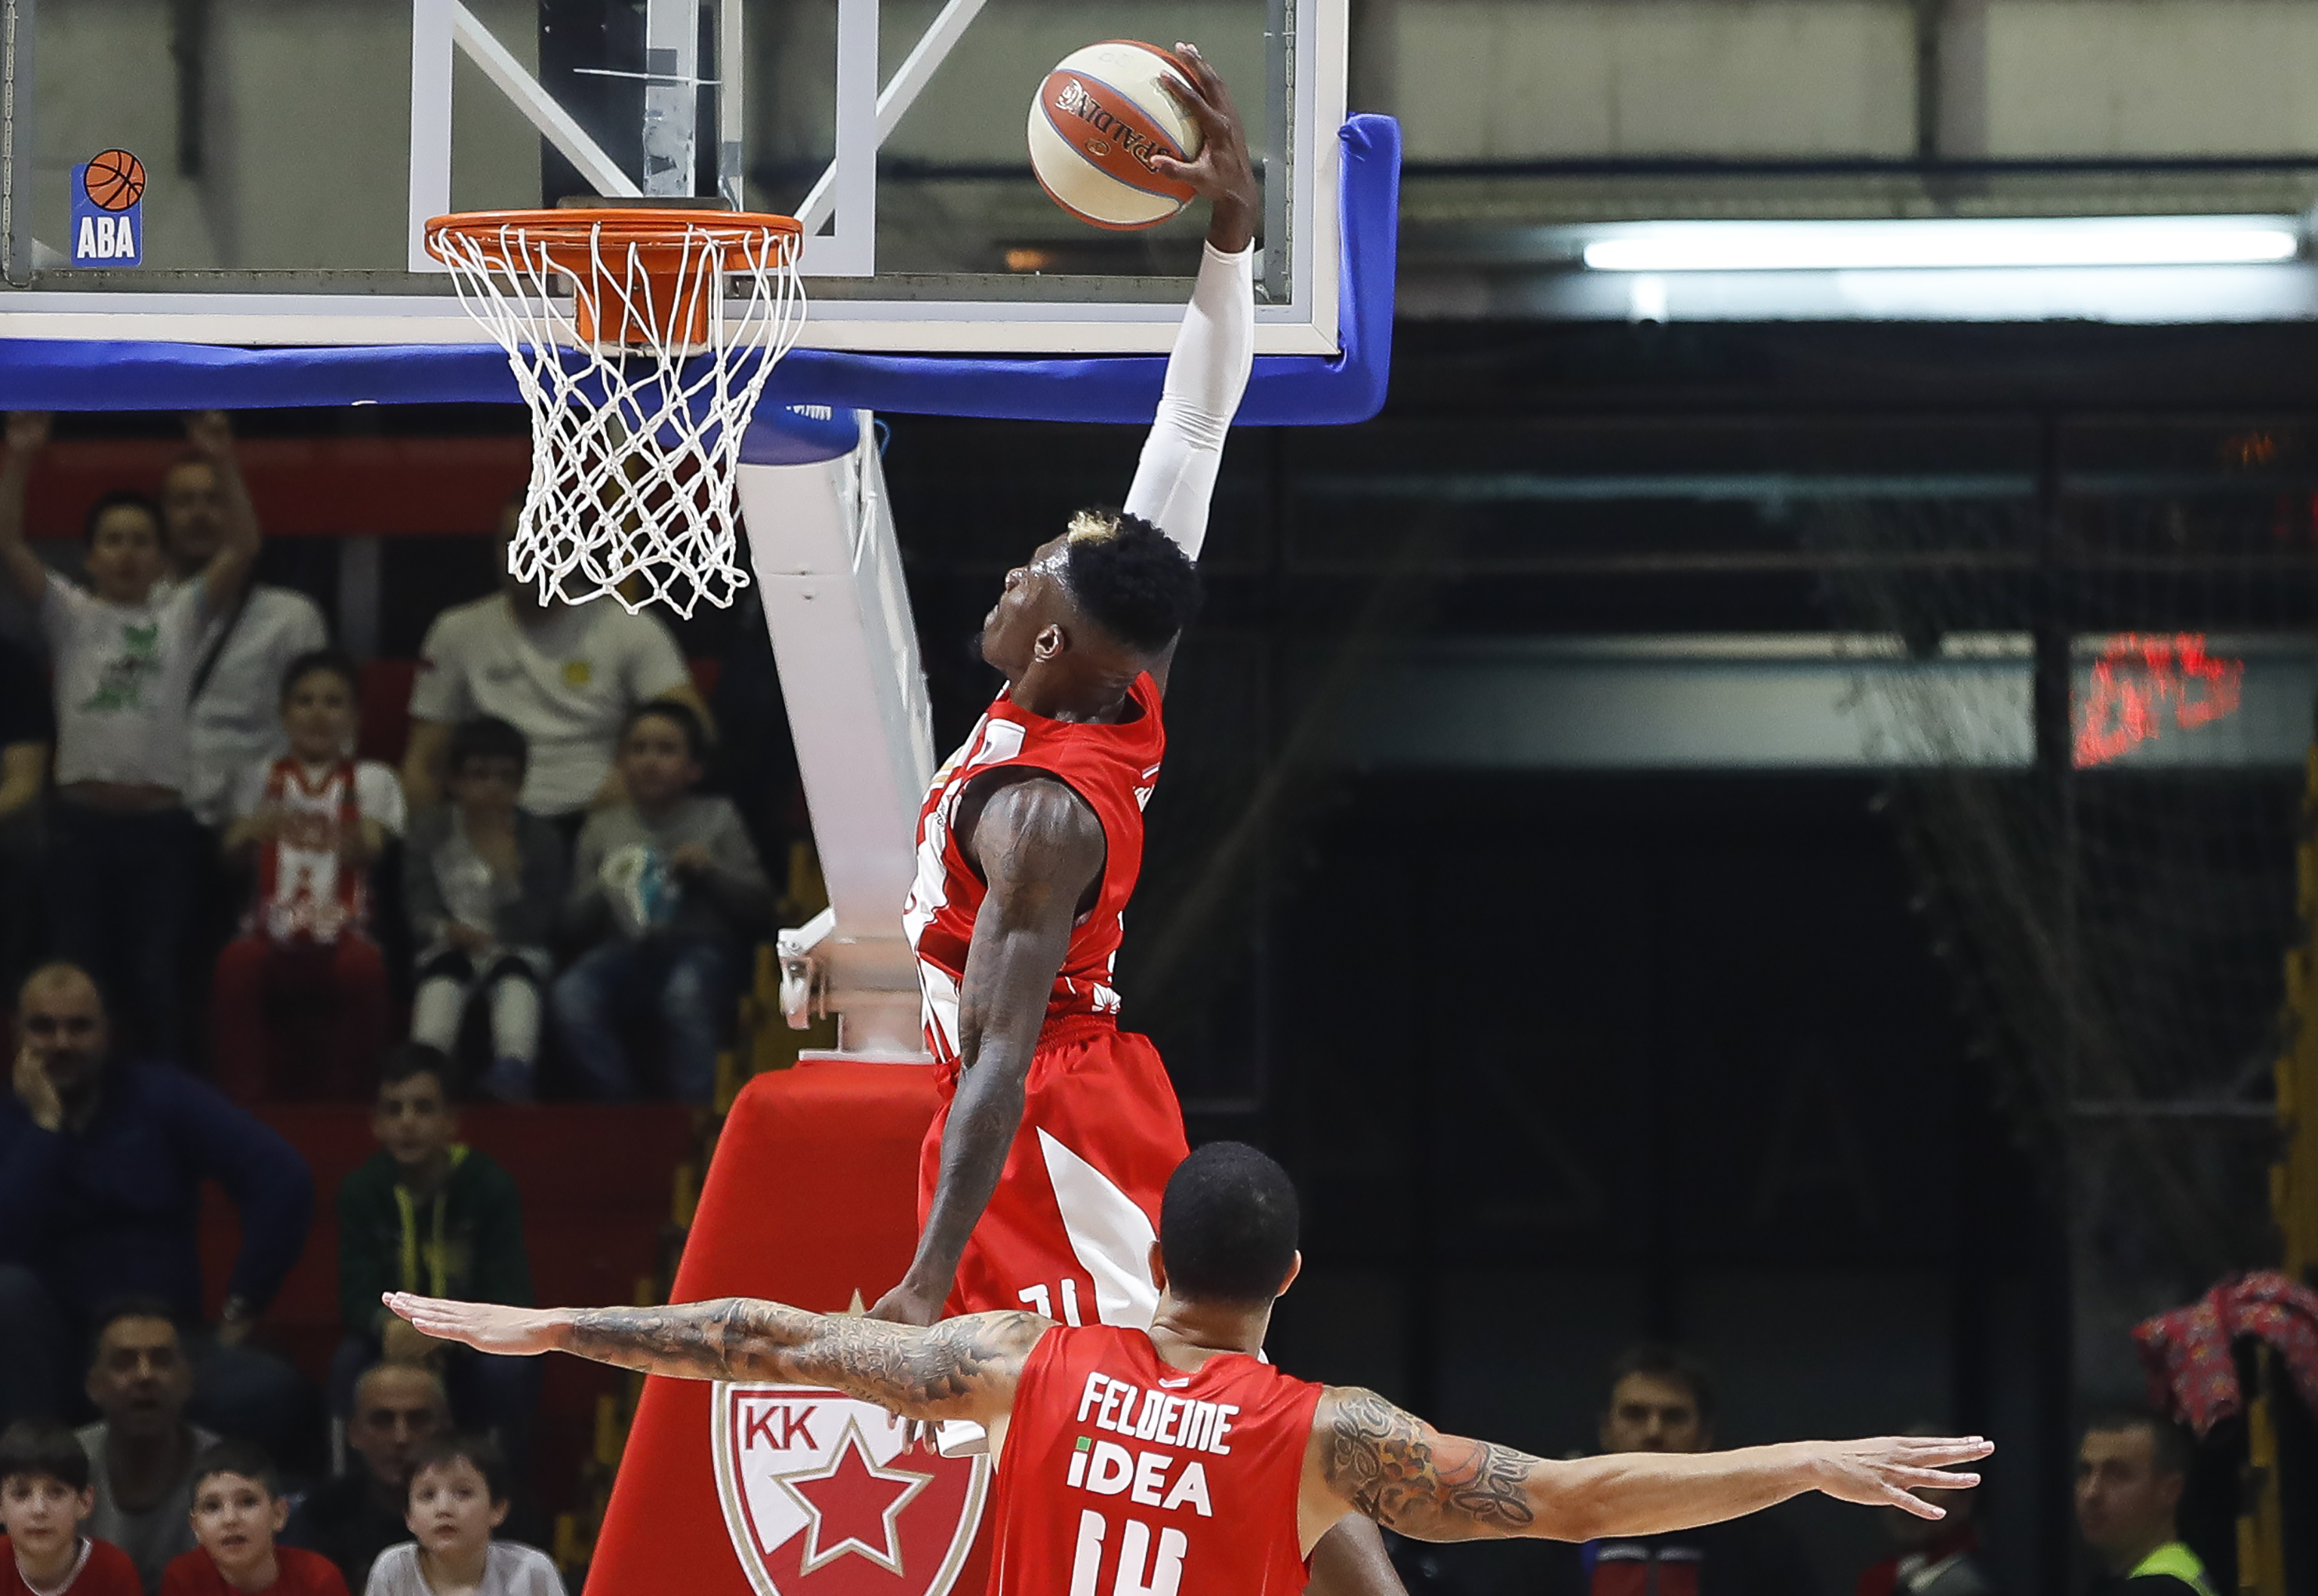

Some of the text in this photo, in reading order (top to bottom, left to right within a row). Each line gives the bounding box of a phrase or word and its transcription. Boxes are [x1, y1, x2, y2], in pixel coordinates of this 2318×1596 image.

[77, 216, 135, 258] ABA
[745, 1406, 818, 1450] KK
[1077, 1372, 1239, 1455] FELDEINE
[1070, 1509, 1188, 1596] 14
